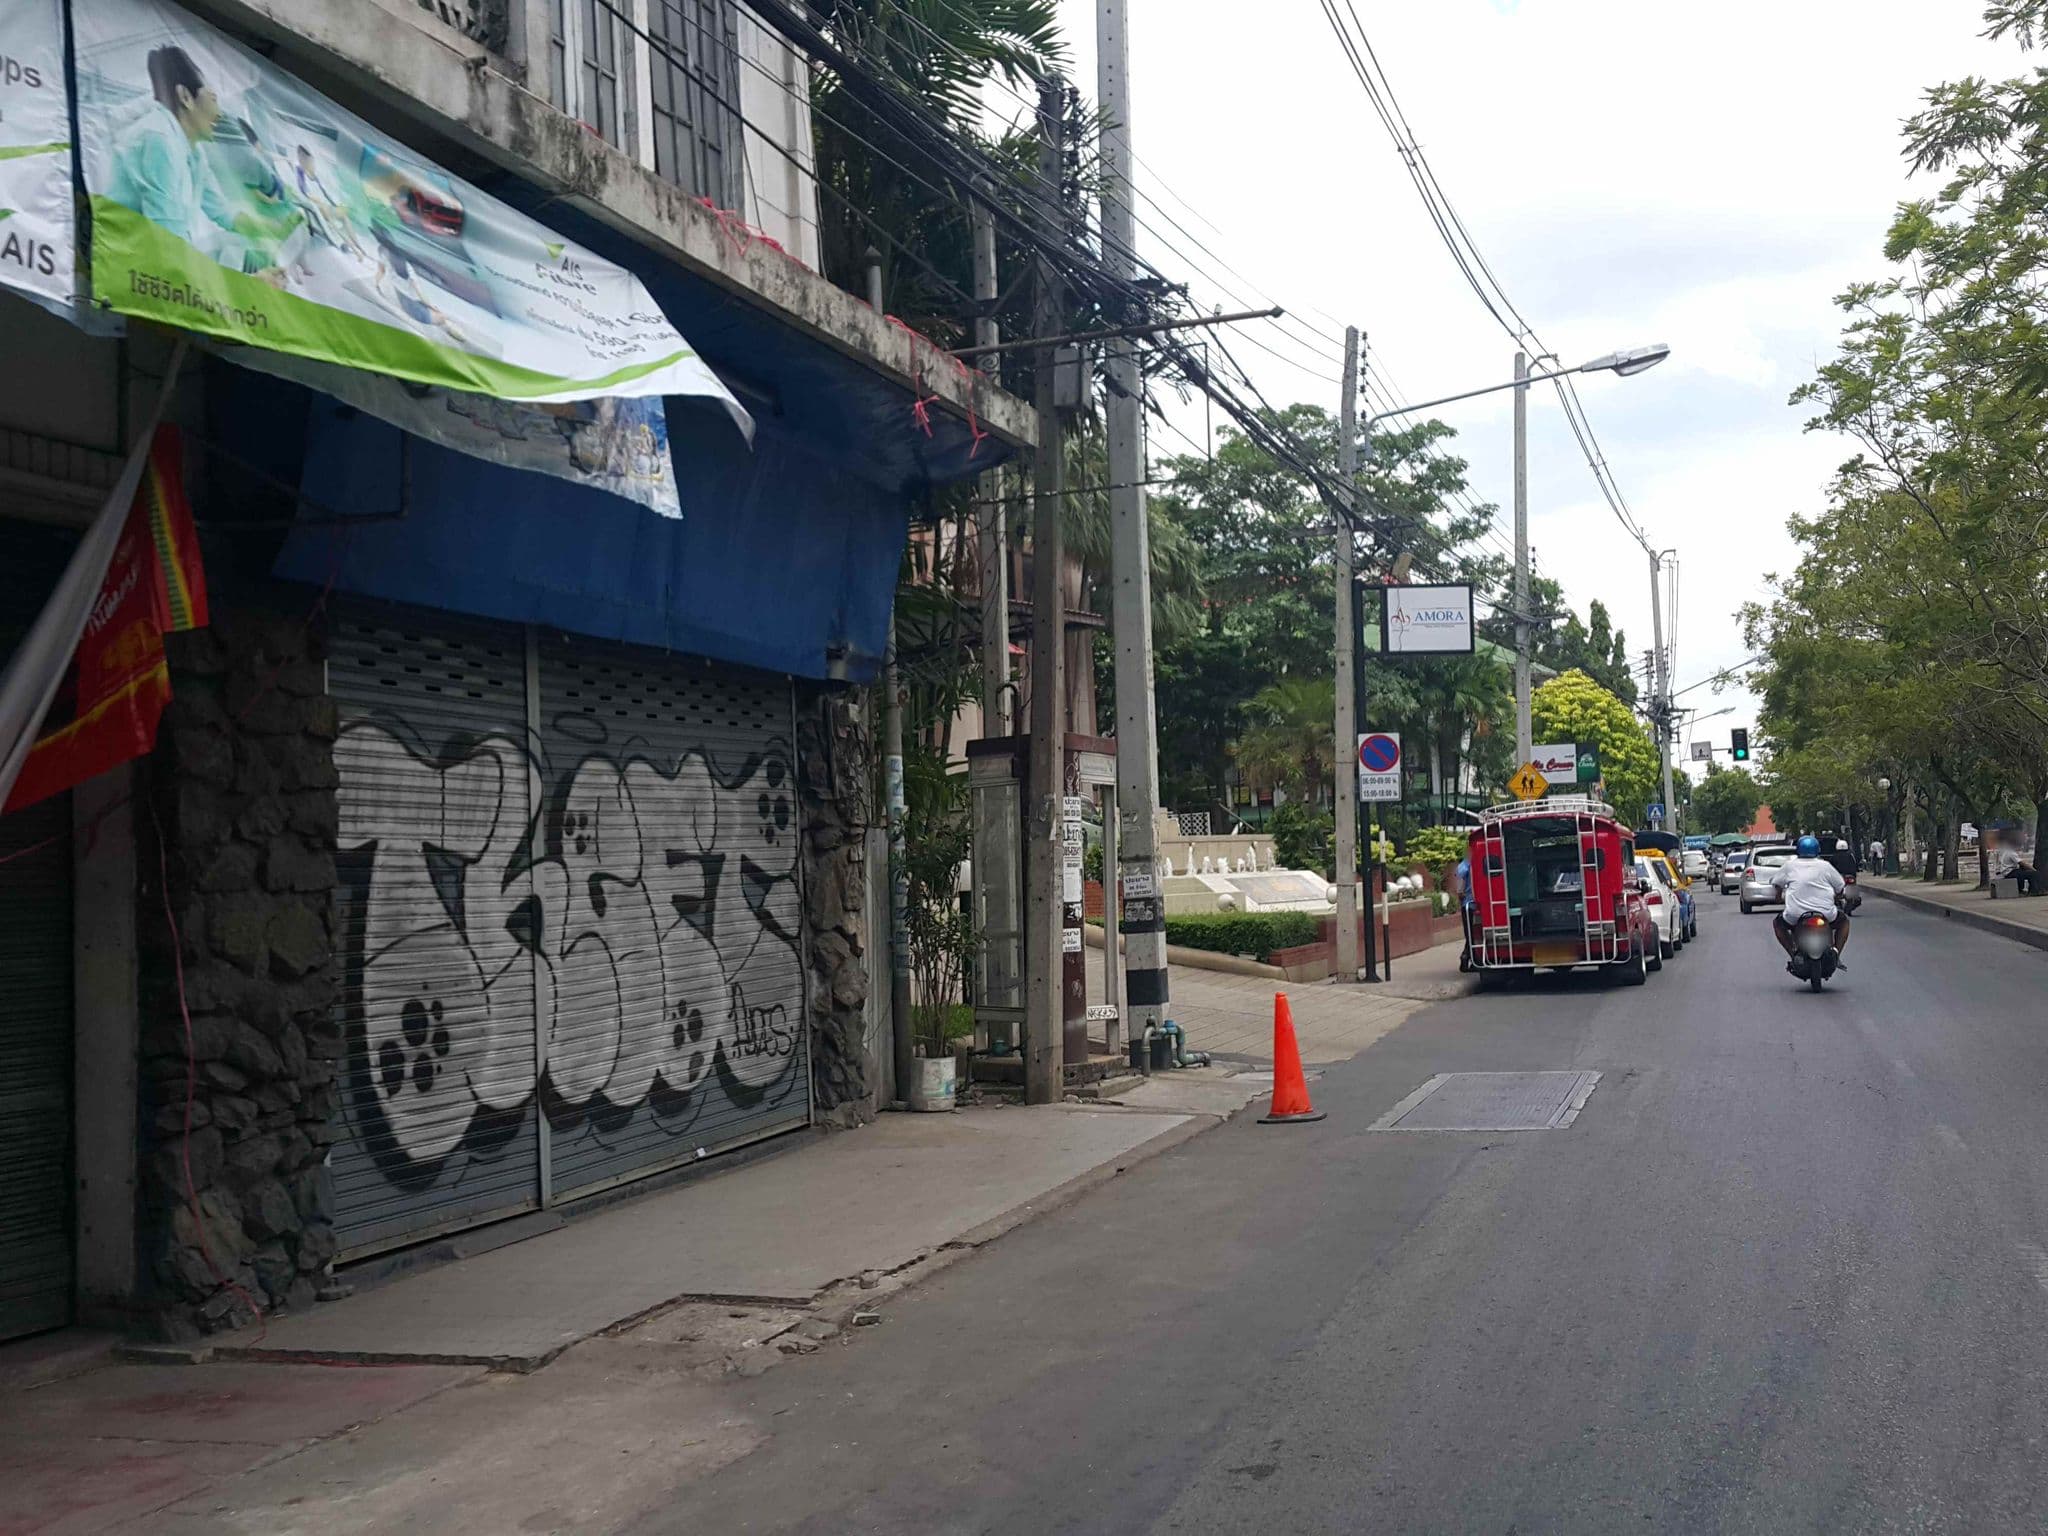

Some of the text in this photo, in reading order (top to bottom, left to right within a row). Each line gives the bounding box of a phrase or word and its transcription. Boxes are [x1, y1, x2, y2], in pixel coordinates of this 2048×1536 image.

[0, 54, 41, 88] ps
[1, 231, 54, 276] AIS
[561, 256, 583, 280] AIS
[536, 263, 597, 295] Fibre
[1414, 610, 1464, 622] AMORA
